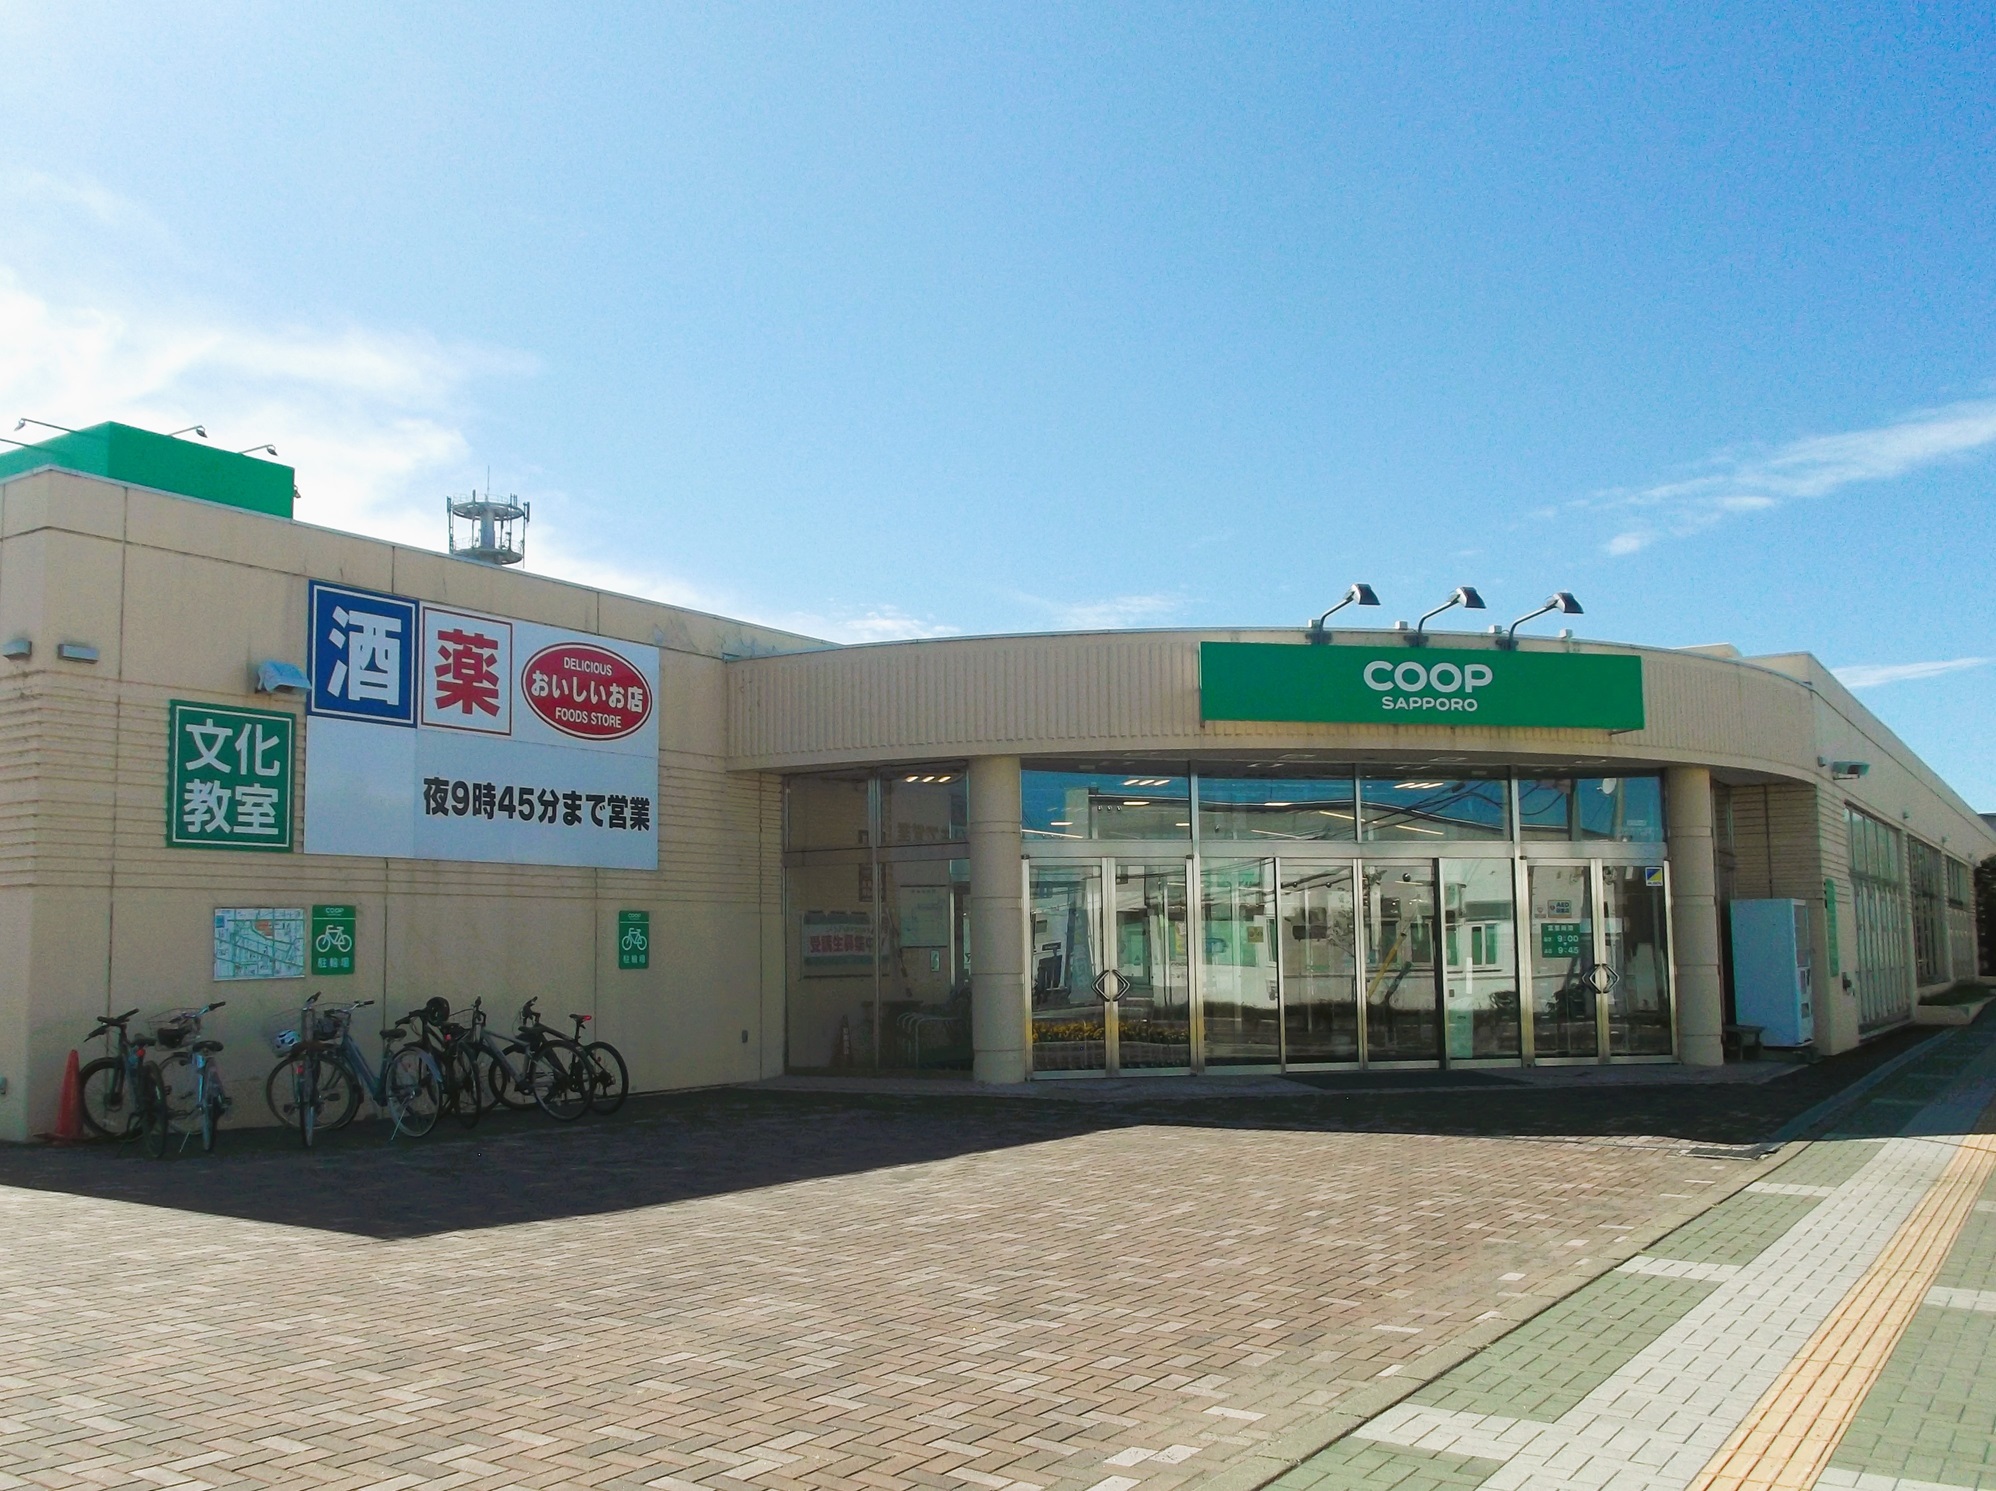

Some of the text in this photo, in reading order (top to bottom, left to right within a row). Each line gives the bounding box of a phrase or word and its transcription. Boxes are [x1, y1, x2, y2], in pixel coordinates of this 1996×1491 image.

[327, 605, 402, 706] 酒
[434, 628, 501, 718] 薬
[563, 656, 613, 677] DELICIOUS
[1363, 660, 1493, 693] COOP
[530, 669, 644, 713] おいしいお店
[1381, 696, 1478, 712] SAPPORO
[555, 706, 622, 729] FOODS STORE
[185, 718, 280, 777] 文化
[183, 778, 279, 835] 教室
[423, 776, 650, 831] 夜9時45分まで営業
